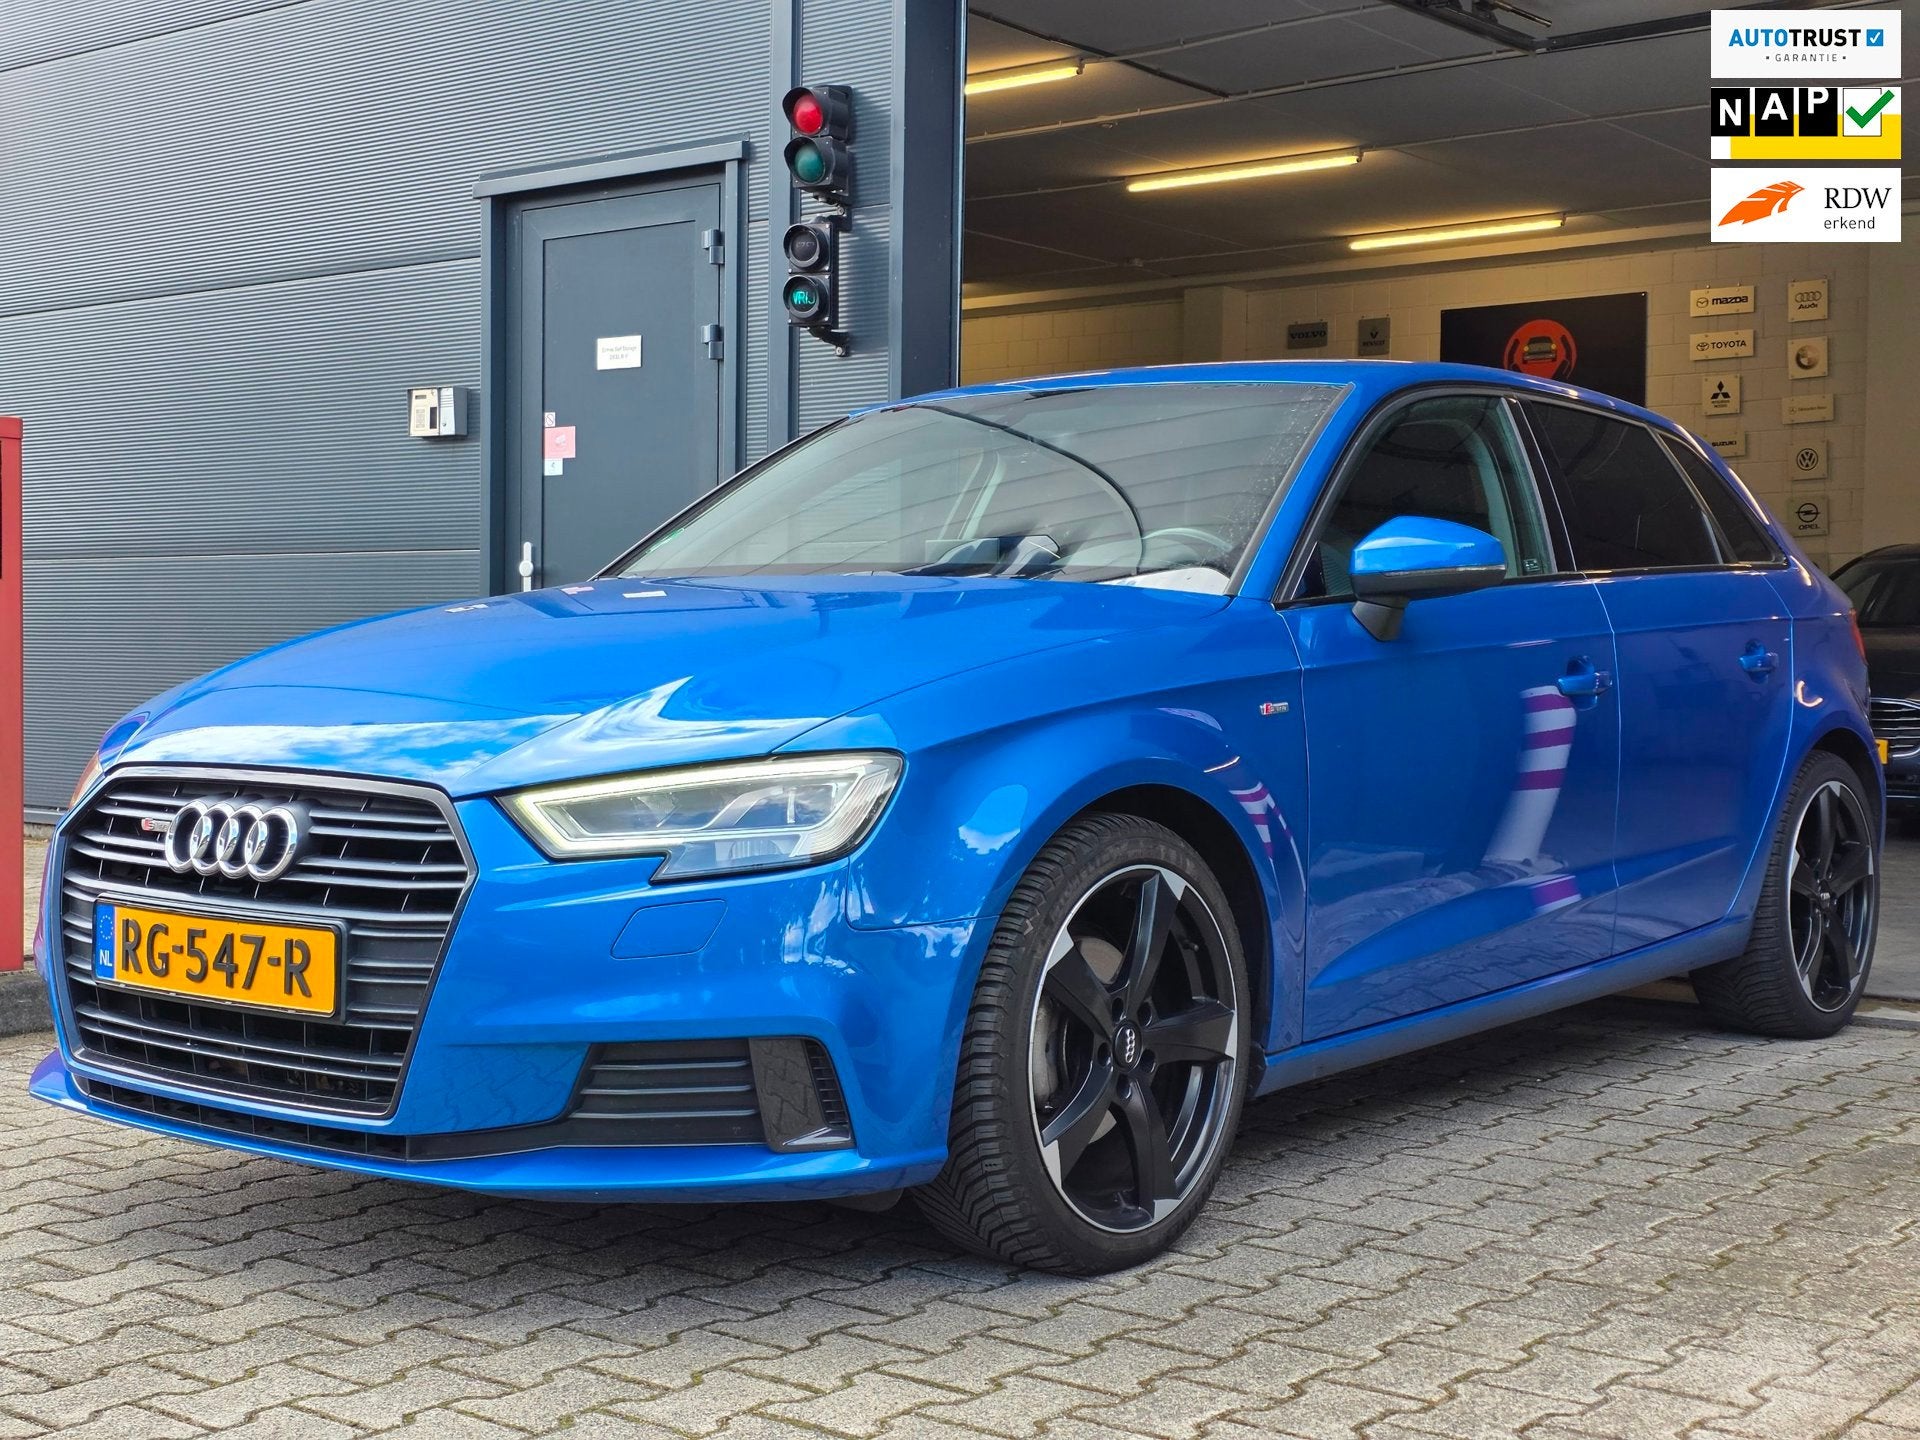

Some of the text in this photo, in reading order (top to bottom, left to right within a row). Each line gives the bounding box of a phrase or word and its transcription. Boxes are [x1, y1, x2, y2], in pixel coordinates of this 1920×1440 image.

[1290, 330, 1327, 339] VOLVO
[1711, 339, 1747, 350] TOYOTA
[1711, 440, 1737, 448] SUZUKI
[99, 949, 112, 967] NL
[121, 917, 312, 998] RG-547-R
